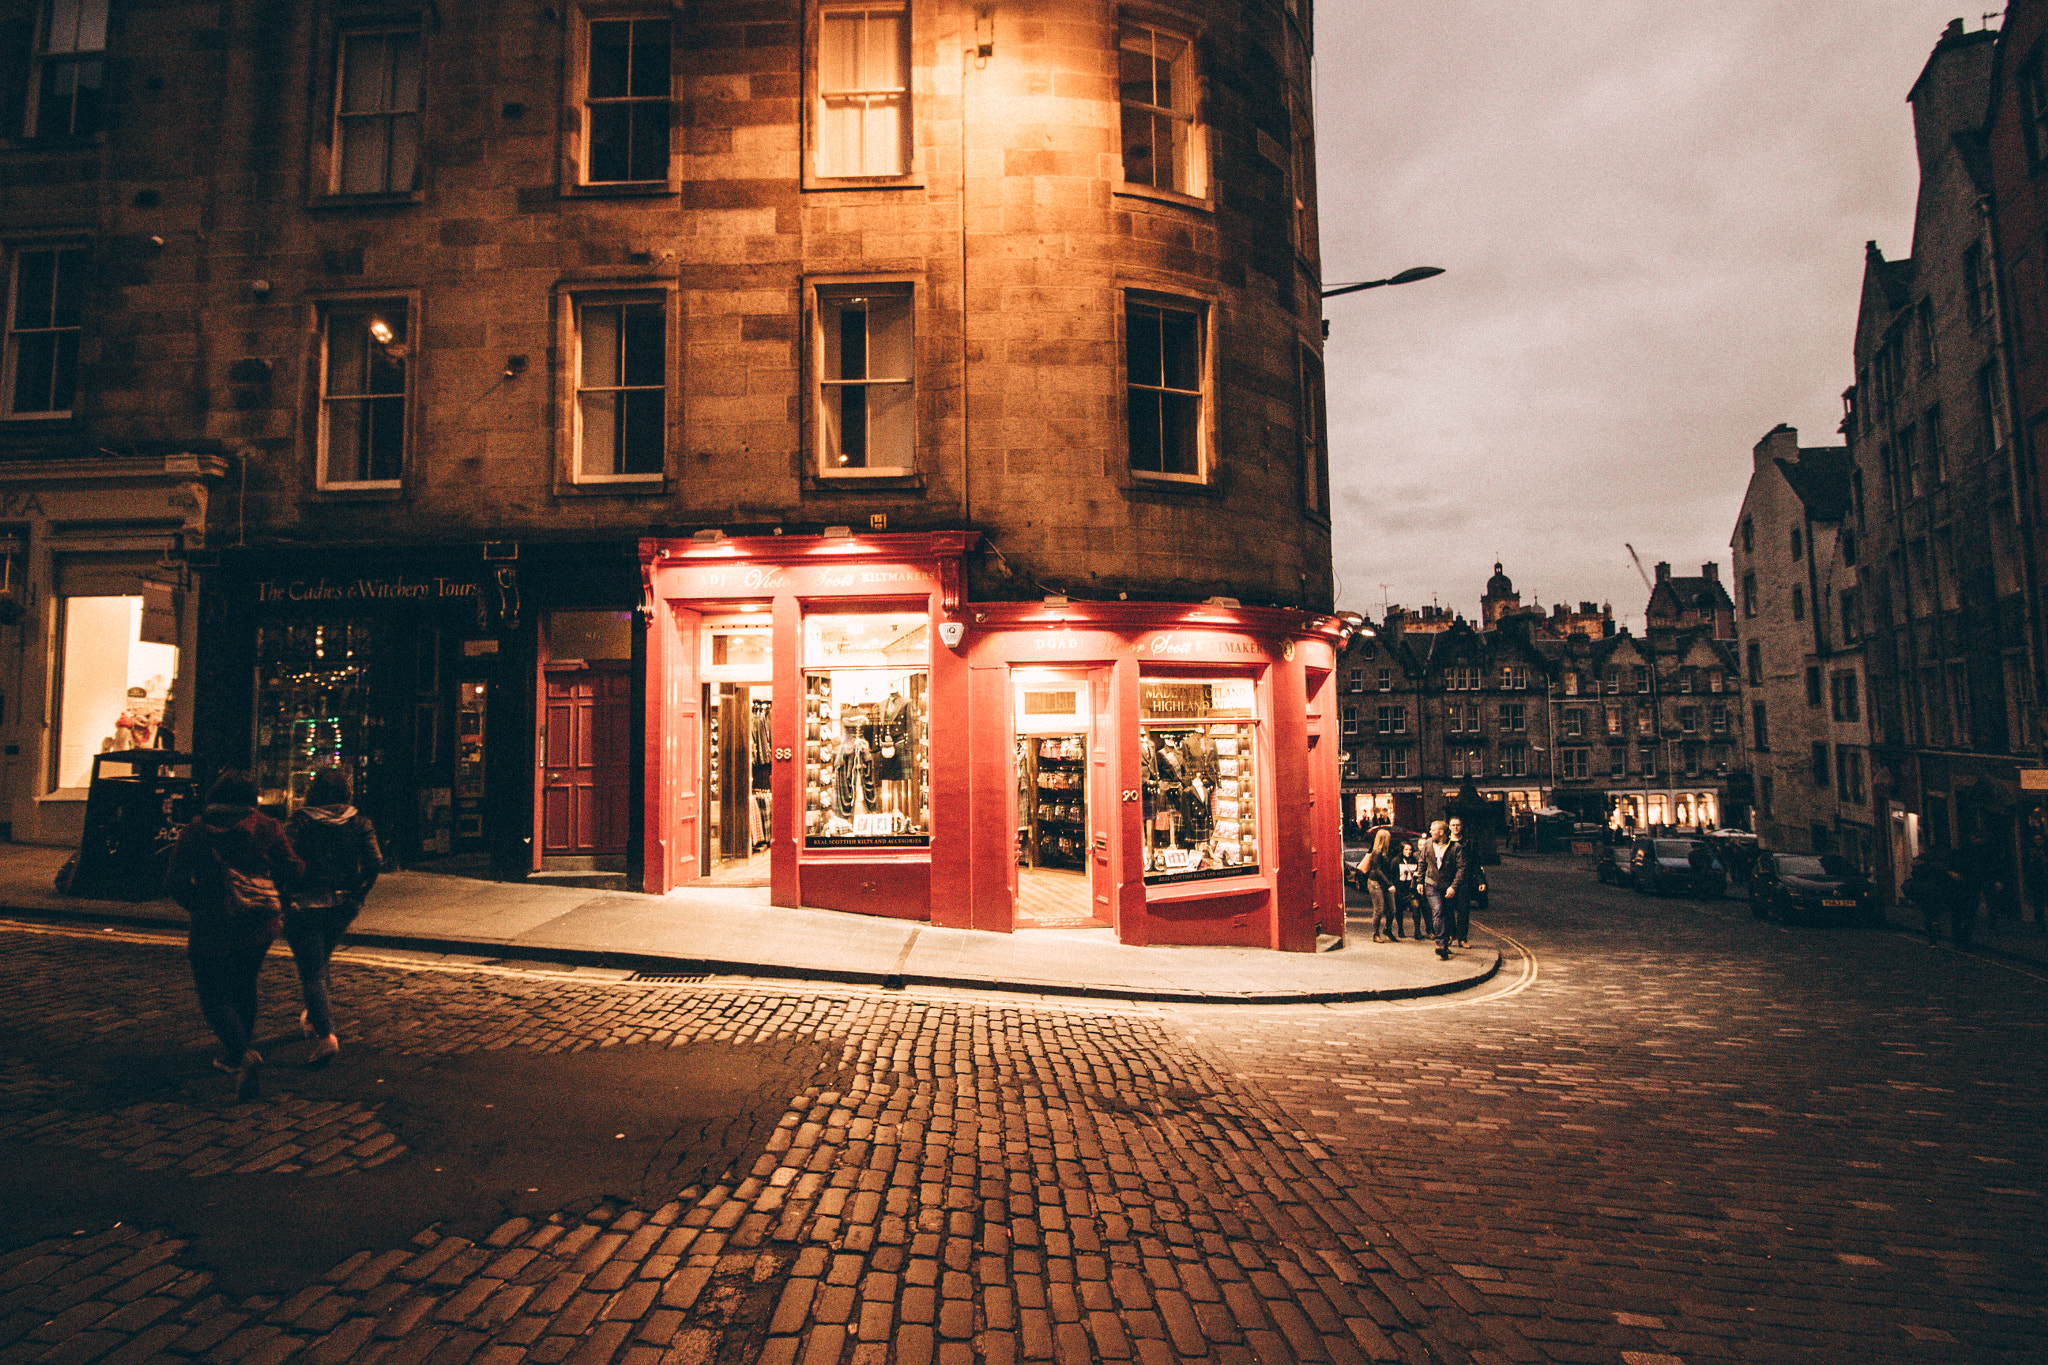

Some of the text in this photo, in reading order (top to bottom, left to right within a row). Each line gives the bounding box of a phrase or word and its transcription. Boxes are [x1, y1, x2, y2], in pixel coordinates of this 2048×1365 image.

[863, 571, 936, 583] KILTMAKERS
[255, 580, 285, 601] The
[288, 578, 343, 601] Cadies
[358, 575, 430, 601] Witchery
[433, 577, 482, 597] Tours
[1151, 634, 1192, 657] Scott
[1194, 640, 1269, 655] KLTMAKERS
[1153, 700, 1210, 712] HIGHLAND
[774, 747, 793, 760] 88
[1122, 790, 1139, 802] 90
